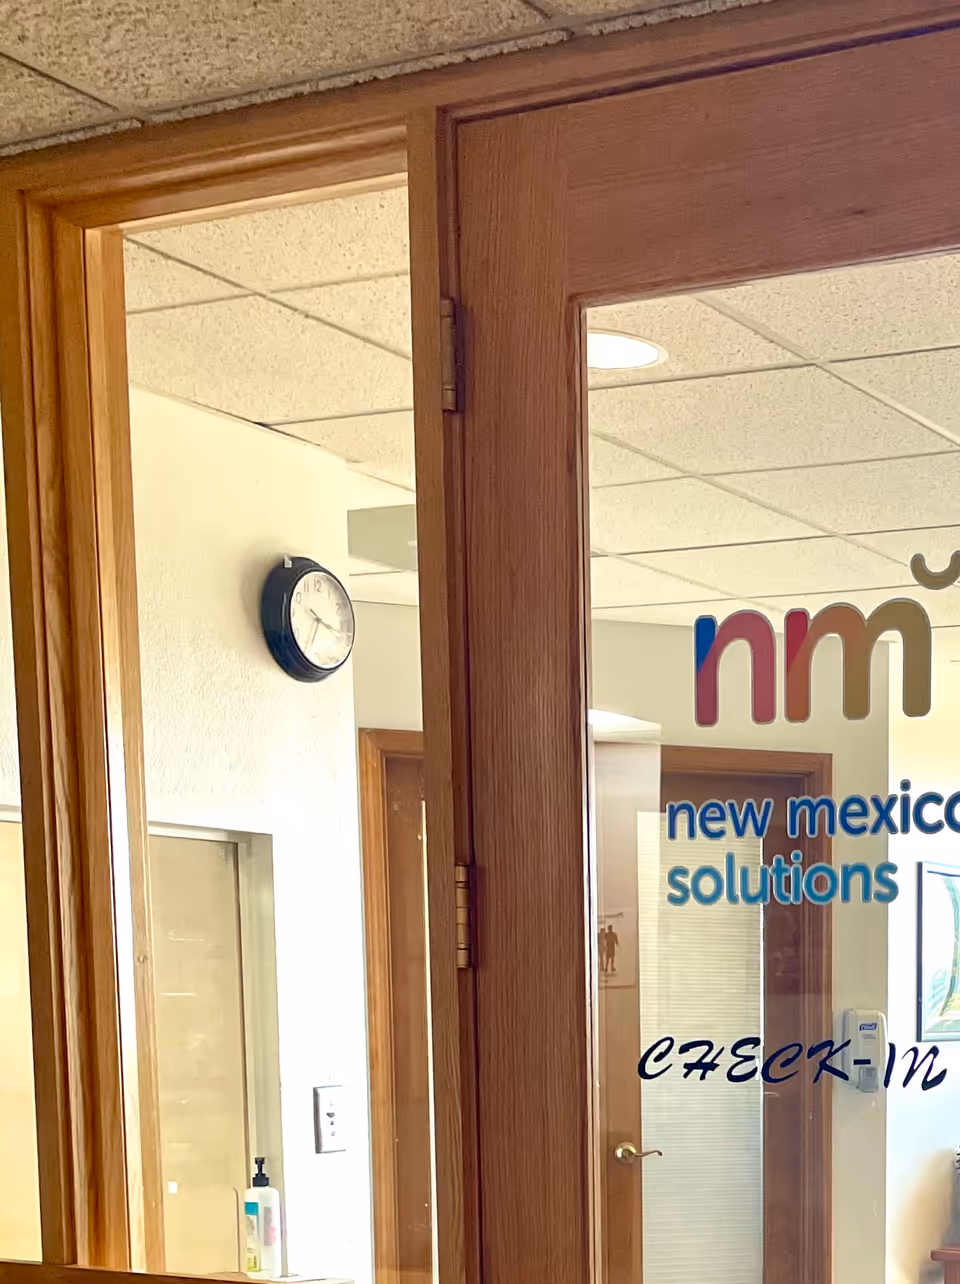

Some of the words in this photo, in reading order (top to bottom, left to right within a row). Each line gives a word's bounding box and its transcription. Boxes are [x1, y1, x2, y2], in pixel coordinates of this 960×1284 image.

[313, 578, 322, 593] 12
[694, 597, 932, 728] nm
[666, 799, 774, 840] new
[666, 849, 899, 905] solutions
[637, 1036, 948, 1091] CHECK-IN
